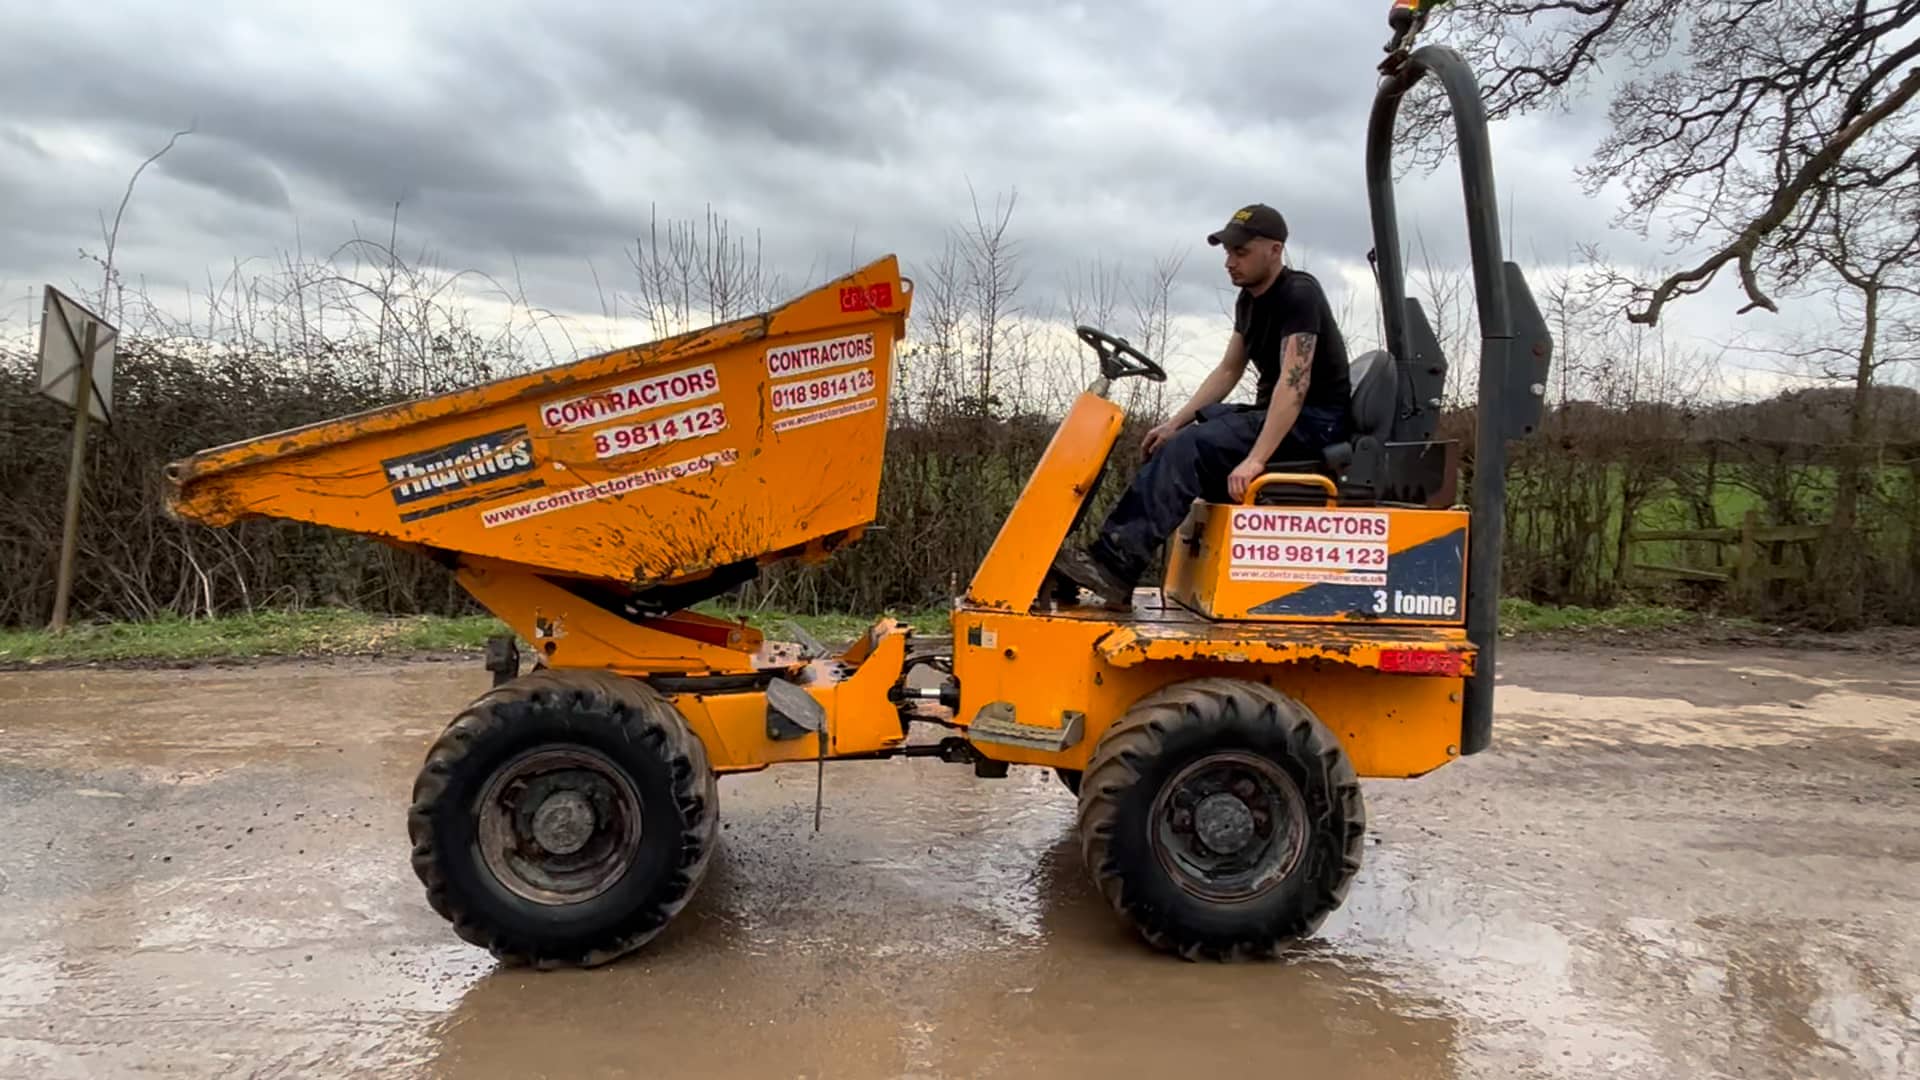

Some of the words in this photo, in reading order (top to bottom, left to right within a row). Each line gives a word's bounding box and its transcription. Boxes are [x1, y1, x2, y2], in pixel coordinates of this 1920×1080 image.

[769, 337, 873, 373] CONTRACTORS
[545, 369, 716, 427] CONTRACTORS
[772, 386, 806, 408] 0118
[389, 440, 531, 497] Thwaites
[1233, 513, 1387, 536] CONTRACTORS
[1232, 543, 1280, 561] 0118
[1372, 590, 1388, 614] 3
[1394, 590, 1456, 616] tonne
